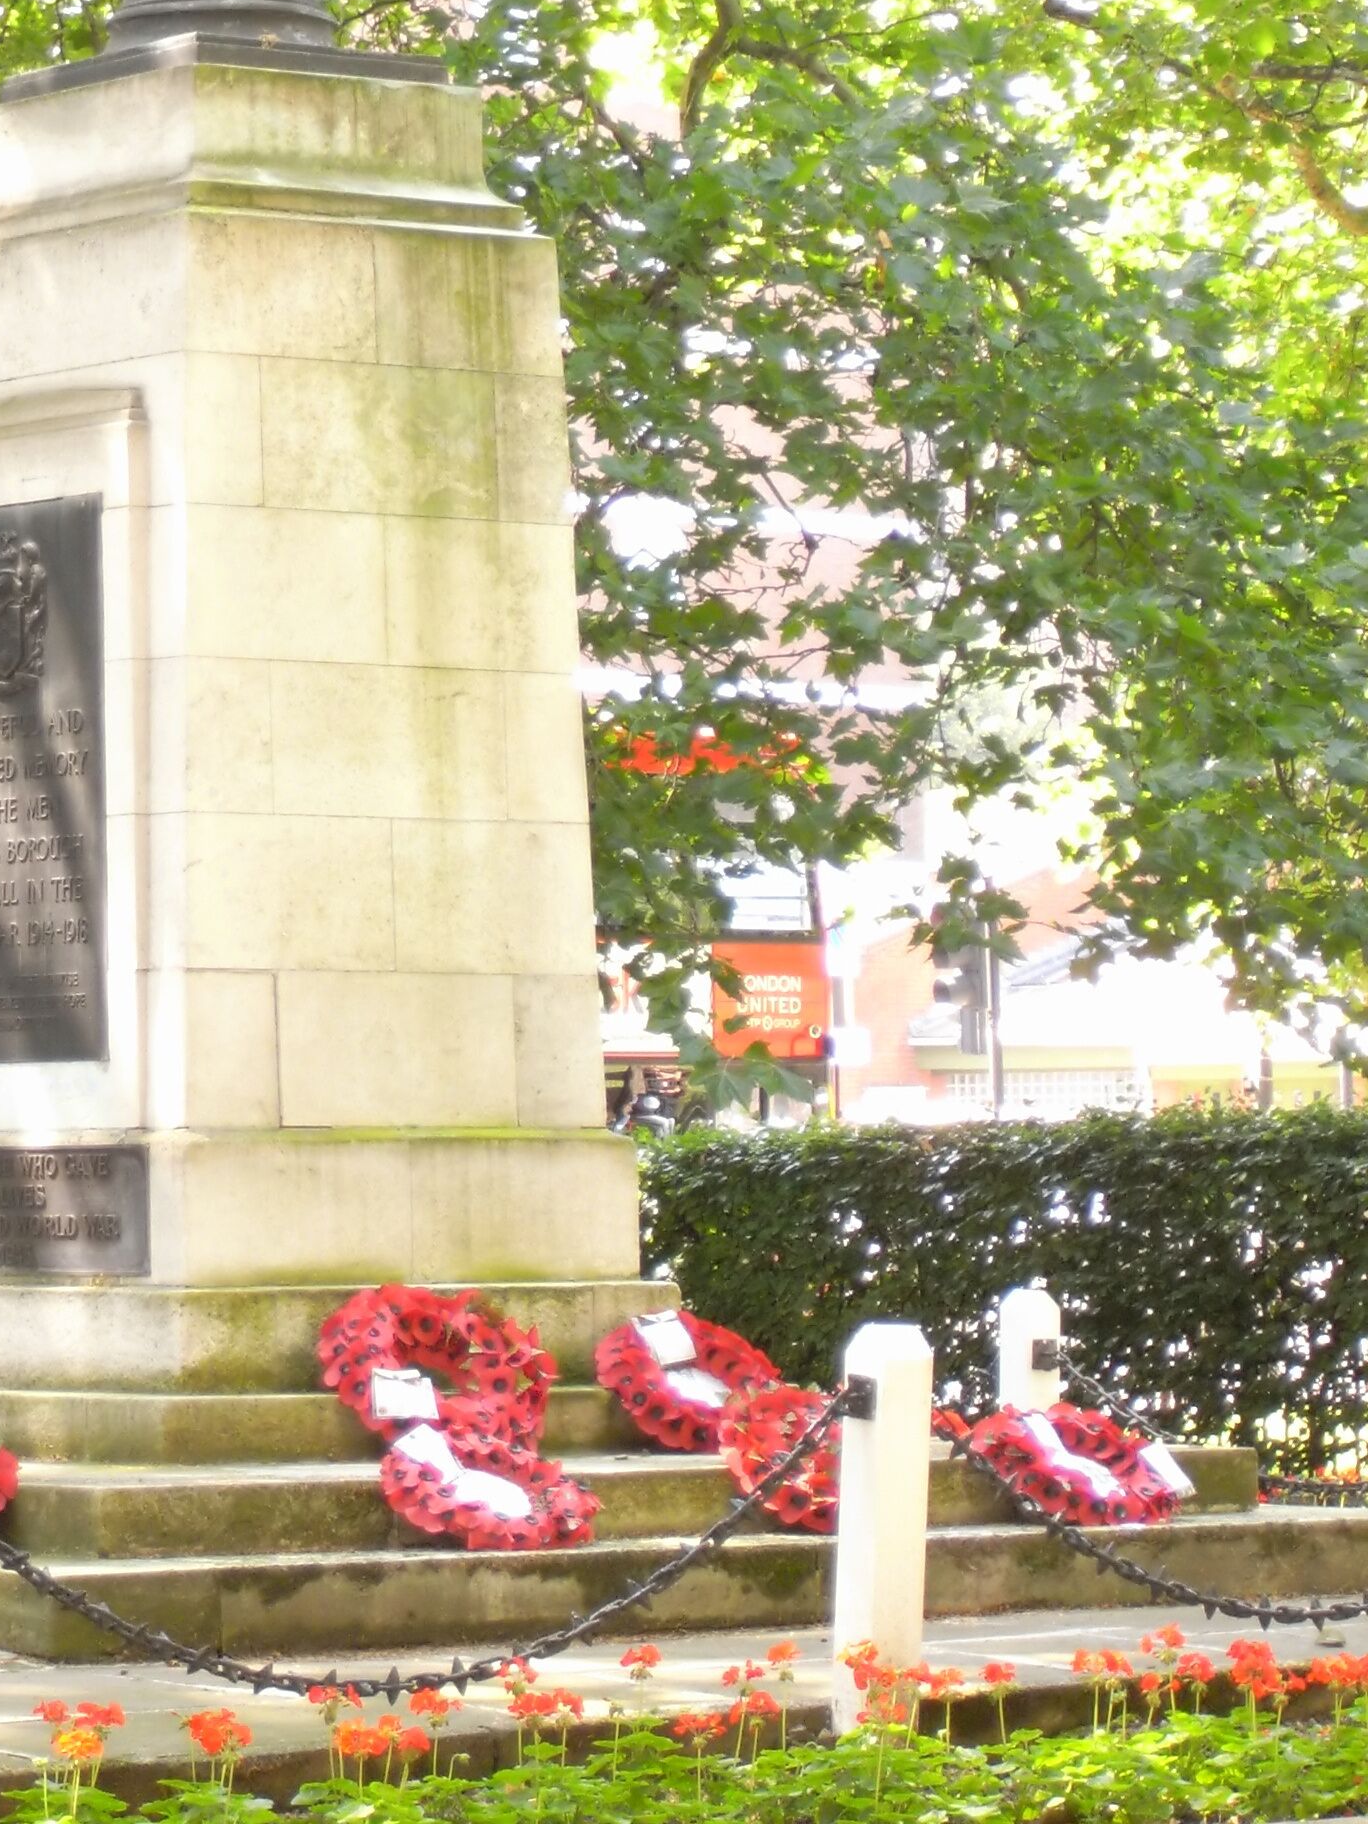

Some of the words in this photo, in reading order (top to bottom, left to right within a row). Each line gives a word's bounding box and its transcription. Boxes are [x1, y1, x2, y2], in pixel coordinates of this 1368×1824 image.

[48, 708, 83, 736] AND
[26, 877, 45, 905] IN
[51, 875, 84, 904] THE
[739, 975, 802, 993] ONDON
[17, 1152, 59, 1181] WHO
[64, 1153, 112, 1179] GAVE
